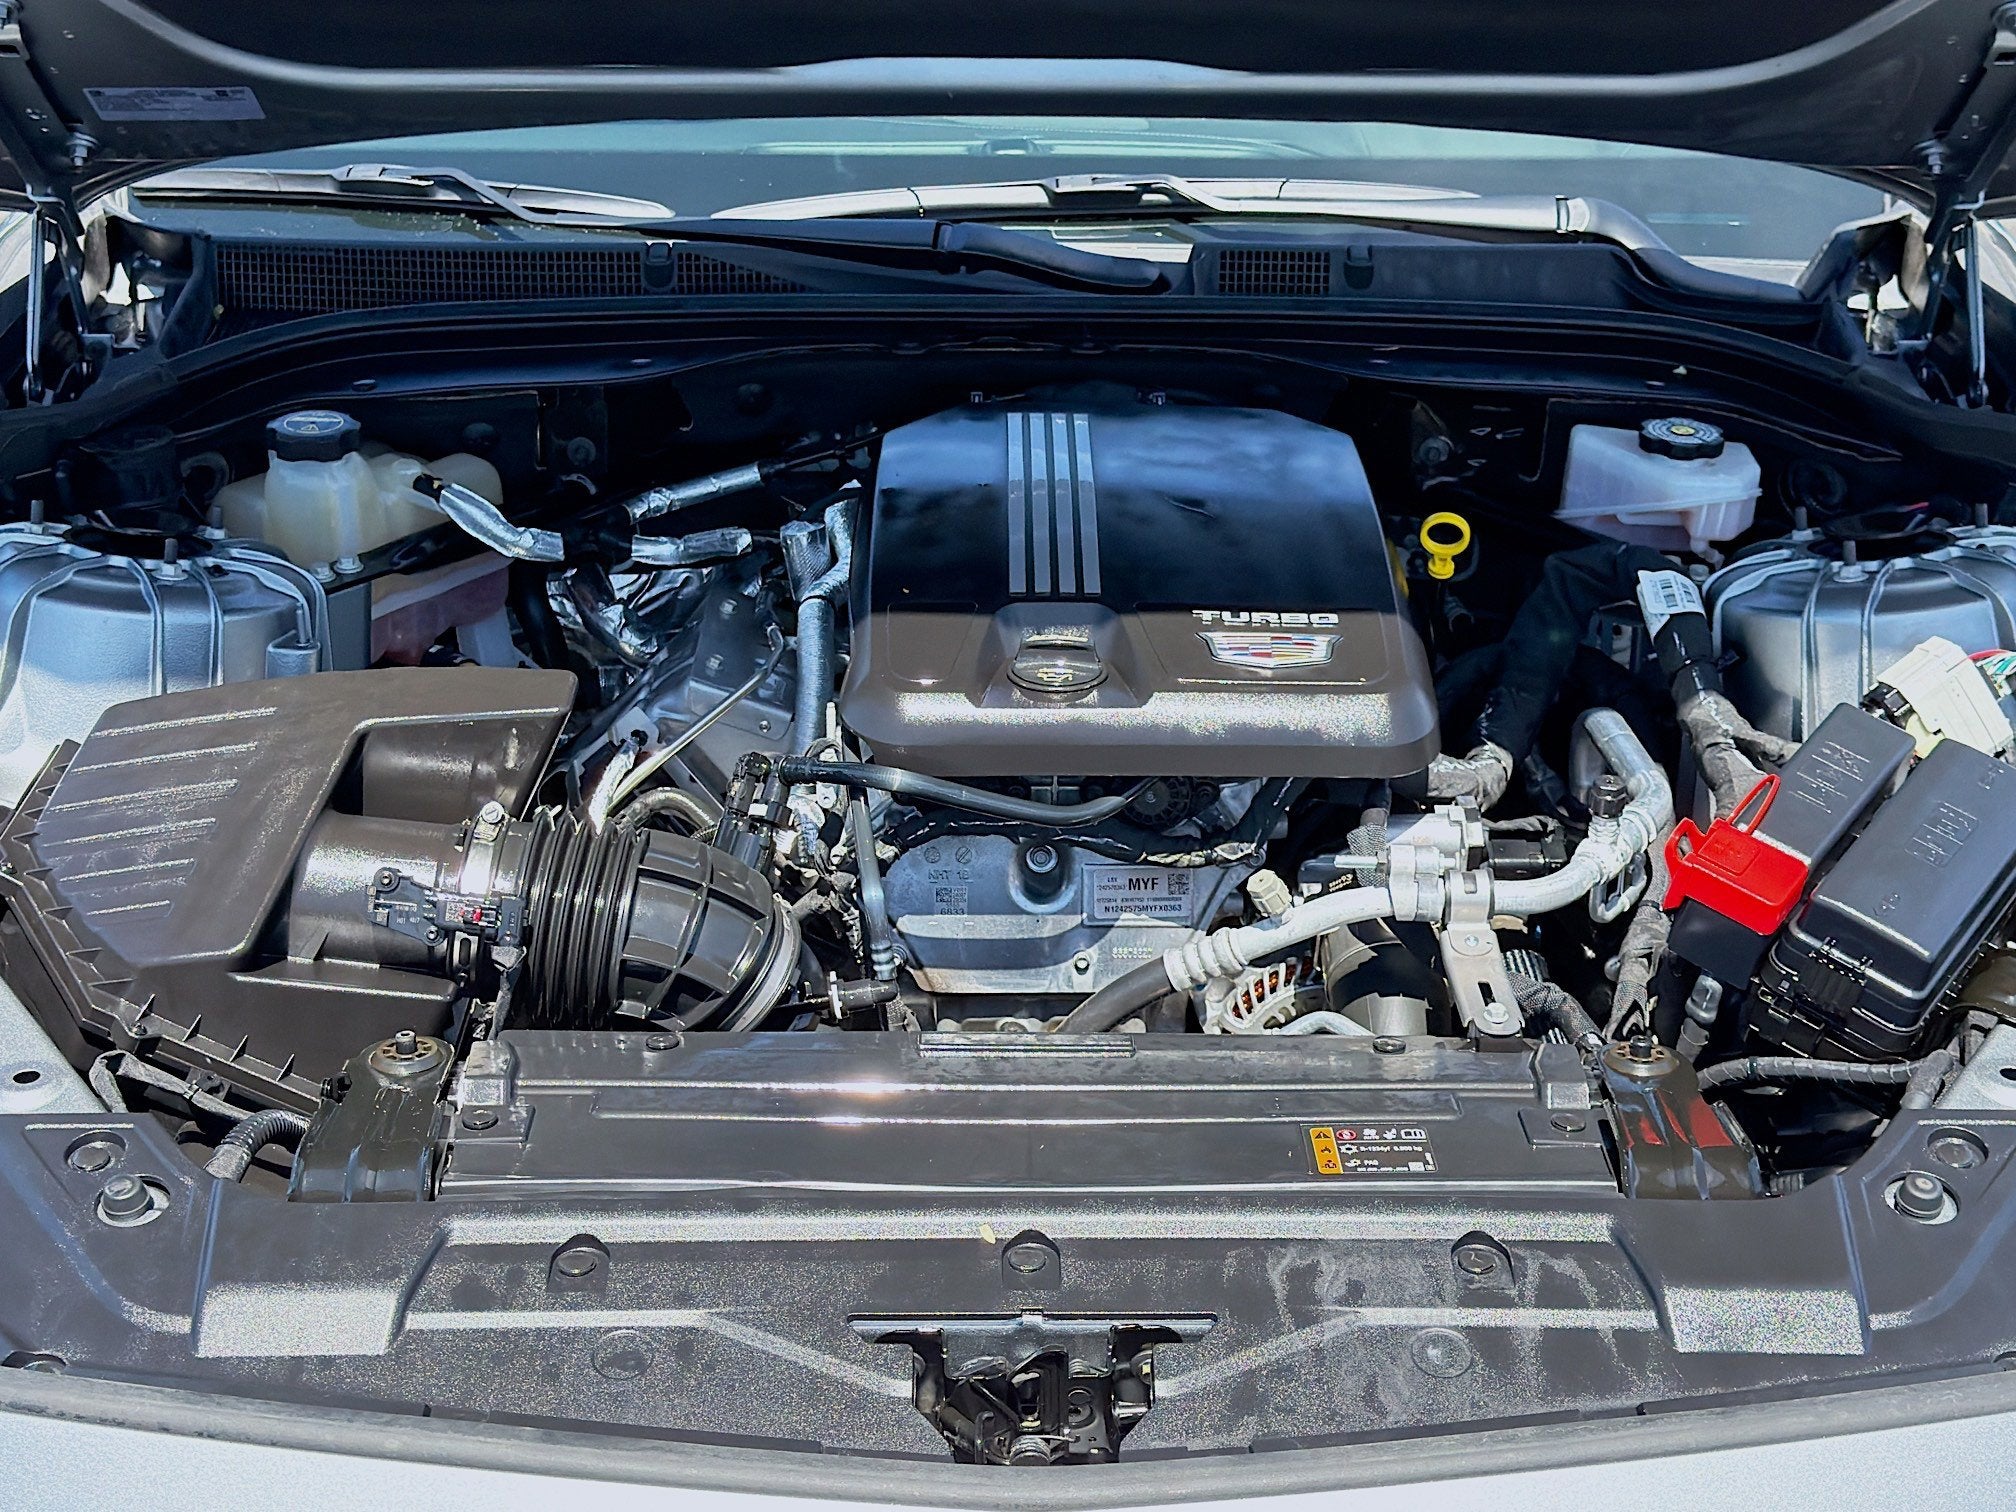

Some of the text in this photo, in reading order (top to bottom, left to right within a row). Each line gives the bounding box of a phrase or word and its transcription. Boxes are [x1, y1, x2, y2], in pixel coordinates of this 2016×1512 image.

[1192, 610, 1340, 627] TURBO
[1128, 877, 1159, 891] MYF
[1104, 904, 1182, 913] N1242575MYFX0363
